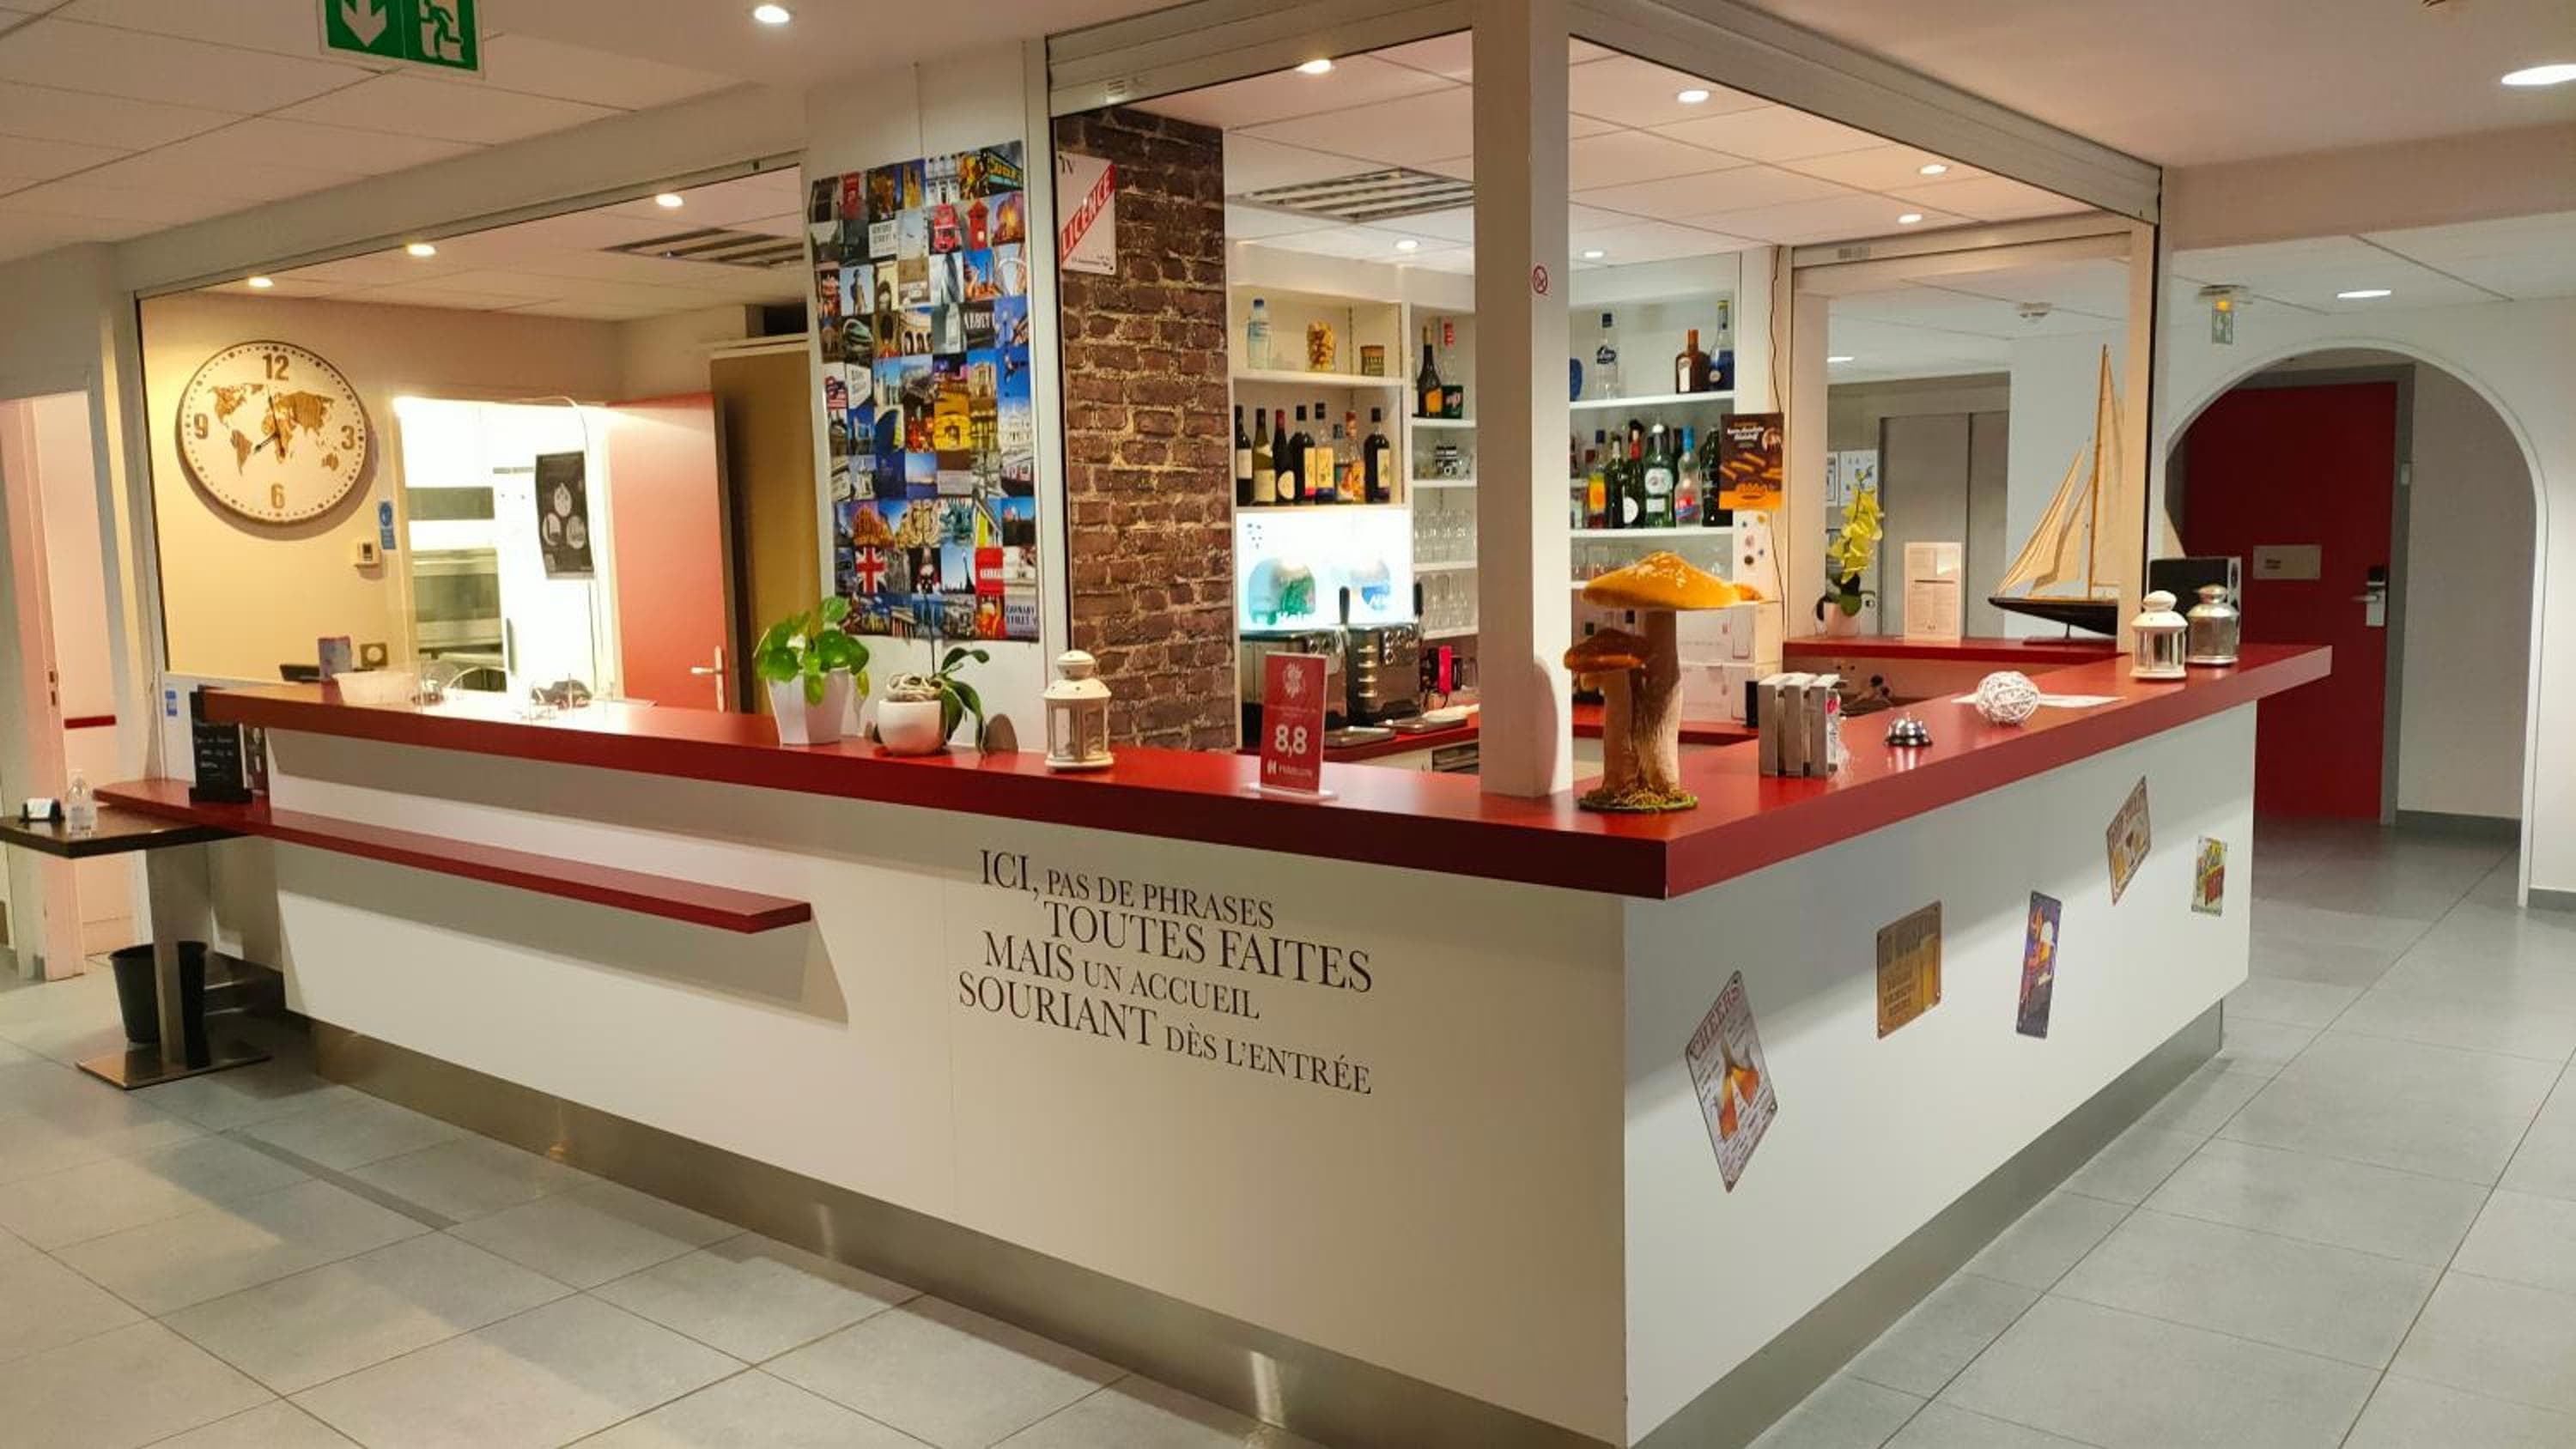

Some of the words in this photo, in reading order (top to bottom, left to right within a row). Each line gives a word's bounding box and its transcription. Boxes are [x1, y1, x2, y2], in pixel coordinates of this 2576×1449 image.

[1062, 167, 1112, 256] LICENCE
[263, 355, 289, 381] 12
[193, 413, 209, 440] 9
[341, 426, 355, 450] 3
[270, 483, 285, 509] 6
[1274, 724, 1308, 758] 8,8
[980, 849, 1039, 901] ICI,
[1048, 869, 1089, 900] PAS
[1097, 877, 1134, 907] DE
[1143, 884, 1274, 929] PHRASES
[982, 931, 1074, 982] MAIS
[1082, 960, 1121, 992] UN
[1130, 970, 1260, 1020] ACCUEIL
[1043, 900, 1206, 963] TOUTES
[1218, 929, 1372, 992] FAITES
[959, 971, 1157, 1046] SOURIANT
[1165, 1022, 1217, 1060] DÈS
[1225, 1038, 1371, 1094] L'ENTRÉE
[1690, 985, 1743, 1062] CHEERS
